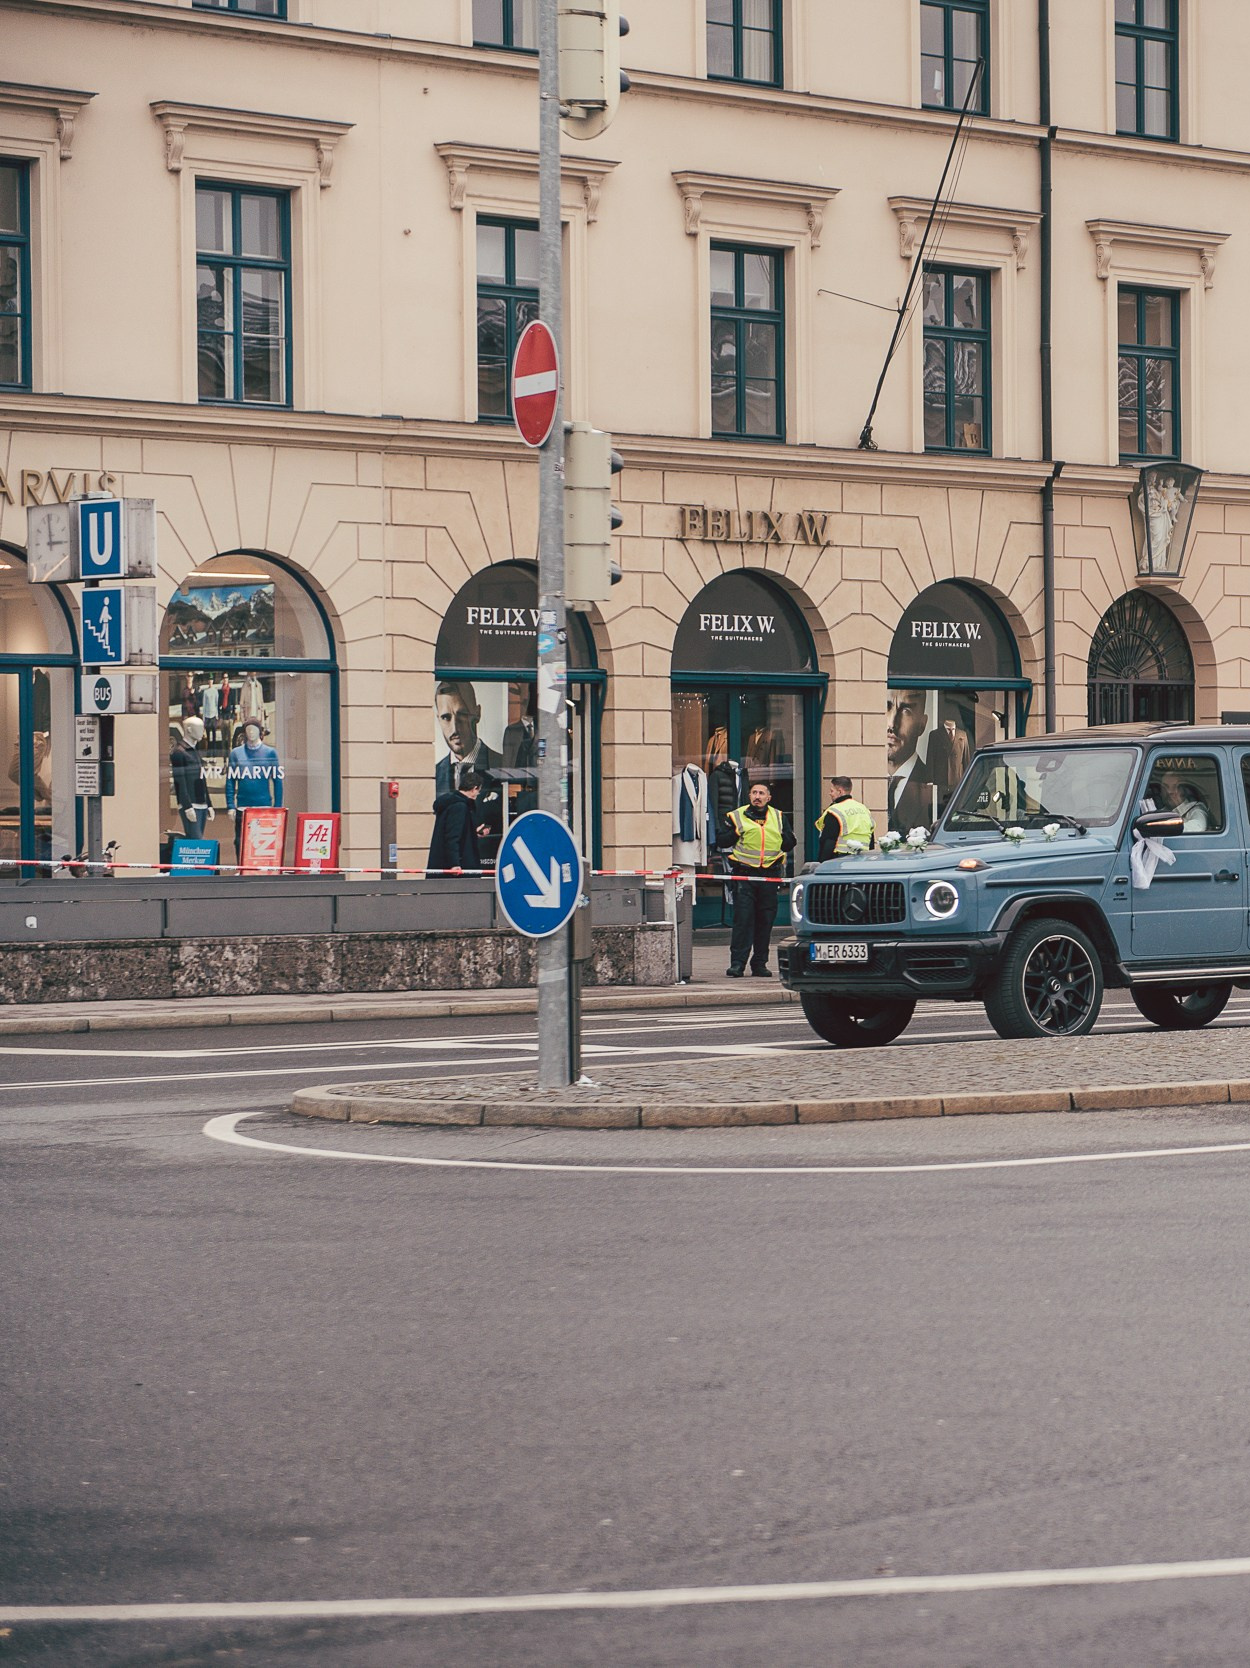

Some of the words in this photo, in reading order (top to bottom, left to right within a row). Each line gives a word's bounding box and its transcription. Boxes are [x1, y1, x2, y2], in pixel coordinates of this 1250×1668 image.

[680, 506, 789, 542] FELIX
[89, 511, 113, 566] U
[466, 606, 526, 627] FELIX
[699, 614, 754, 633] FELIX
[758, 616, 776, 634] W.
[911, 621, 961, 639] FELIX
[964, 623, 982, 640] W.
[94, 687, 111, 701] BUS
[200, 766, 224, 780] MR
[228, 766, 285, 780] MARVIS
[842, 945, 867, 959] 6333
